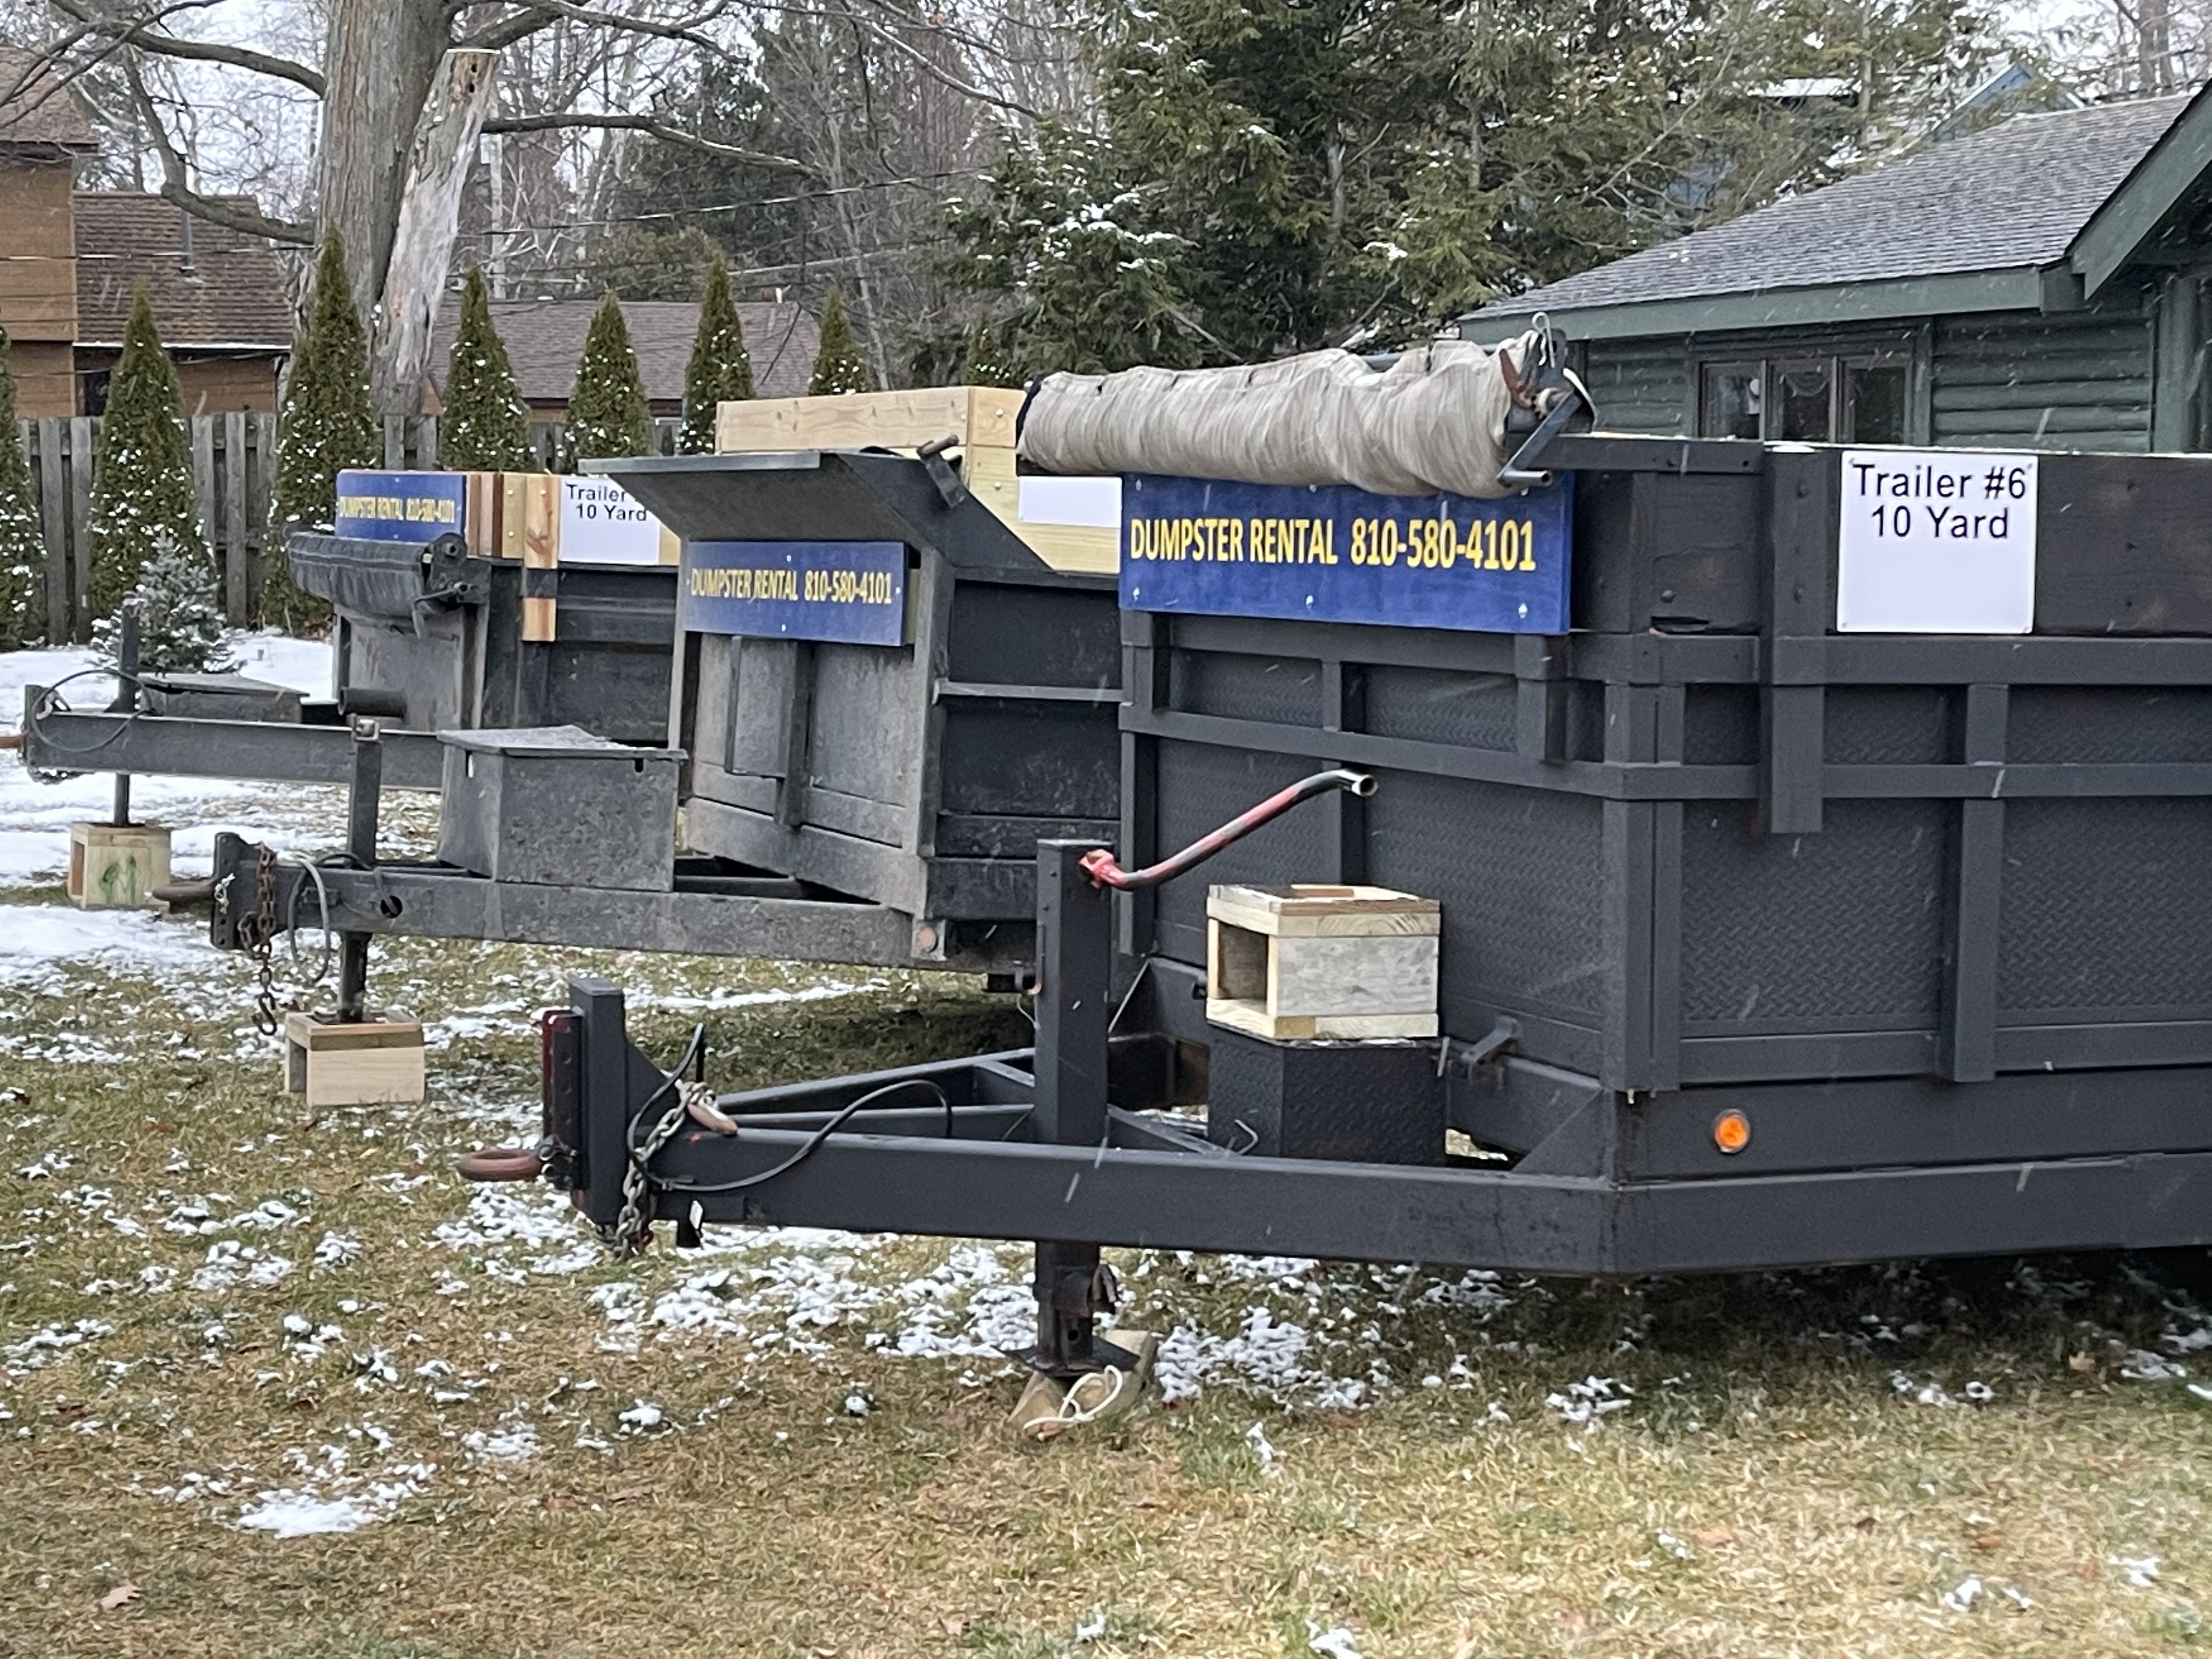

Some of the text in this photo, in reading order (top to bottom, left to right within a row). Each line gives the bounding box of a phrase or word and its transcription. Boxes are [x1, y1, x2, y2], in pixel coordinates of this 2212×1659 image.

[565, 482, 626, 502] Trailer
[1853, 463, 2026, 499] Trailer #6
[577, 503, 647, 521] 10 Yard
[1871, 504, 2010, 539] 10 Yard
[1130, 518, 1537, 572] DUMPSTER RENTAL 810-580-4101
[691, 568, 892, 604] DUMPSTER RENTAL 810-580-4101
